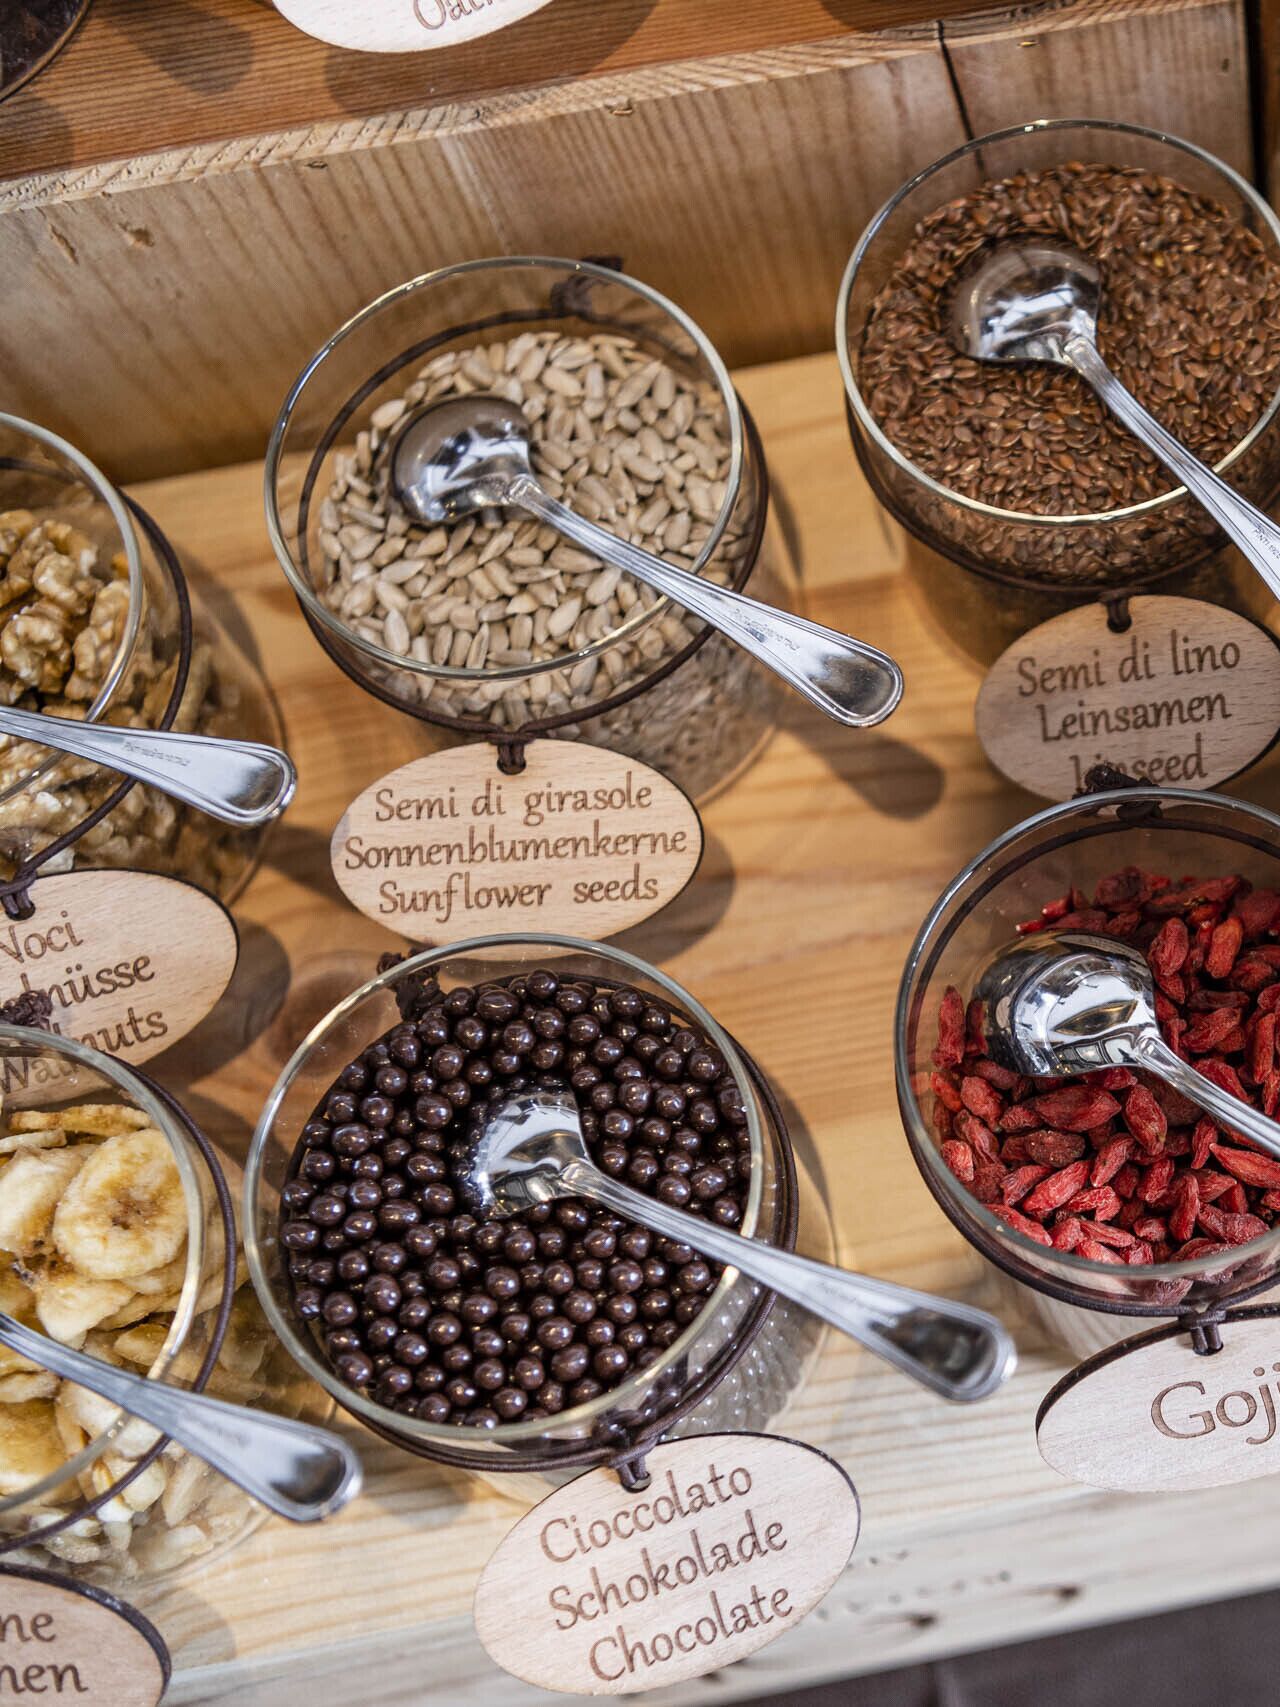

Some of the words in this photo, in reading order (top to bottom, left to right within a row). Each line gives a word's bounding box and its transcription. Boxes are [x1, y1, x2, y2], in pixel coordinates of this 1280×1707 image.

[1017, 651, 1105, 697] Semi
[1119, 635, 1155, 682] di
[1171, 629, 1241, 676] lino
[1035, 692, 1232, 743] Leinsamen
[375, 786, 460, 822] Semi
[471, 778, 506, 816] di
[523, 770, 653, 827] girasole
[344, 818, 688, 870] Sonnenblumenkerne
[379, 870, 552, 924] Sunflower
[573, 861, 659, 903] seeds
[540, 1463, 753, 1564] Cioccolato
[549, 1508, 788, 1631] Schokolade
[588, 1584, 794, 1682] Chocolate
